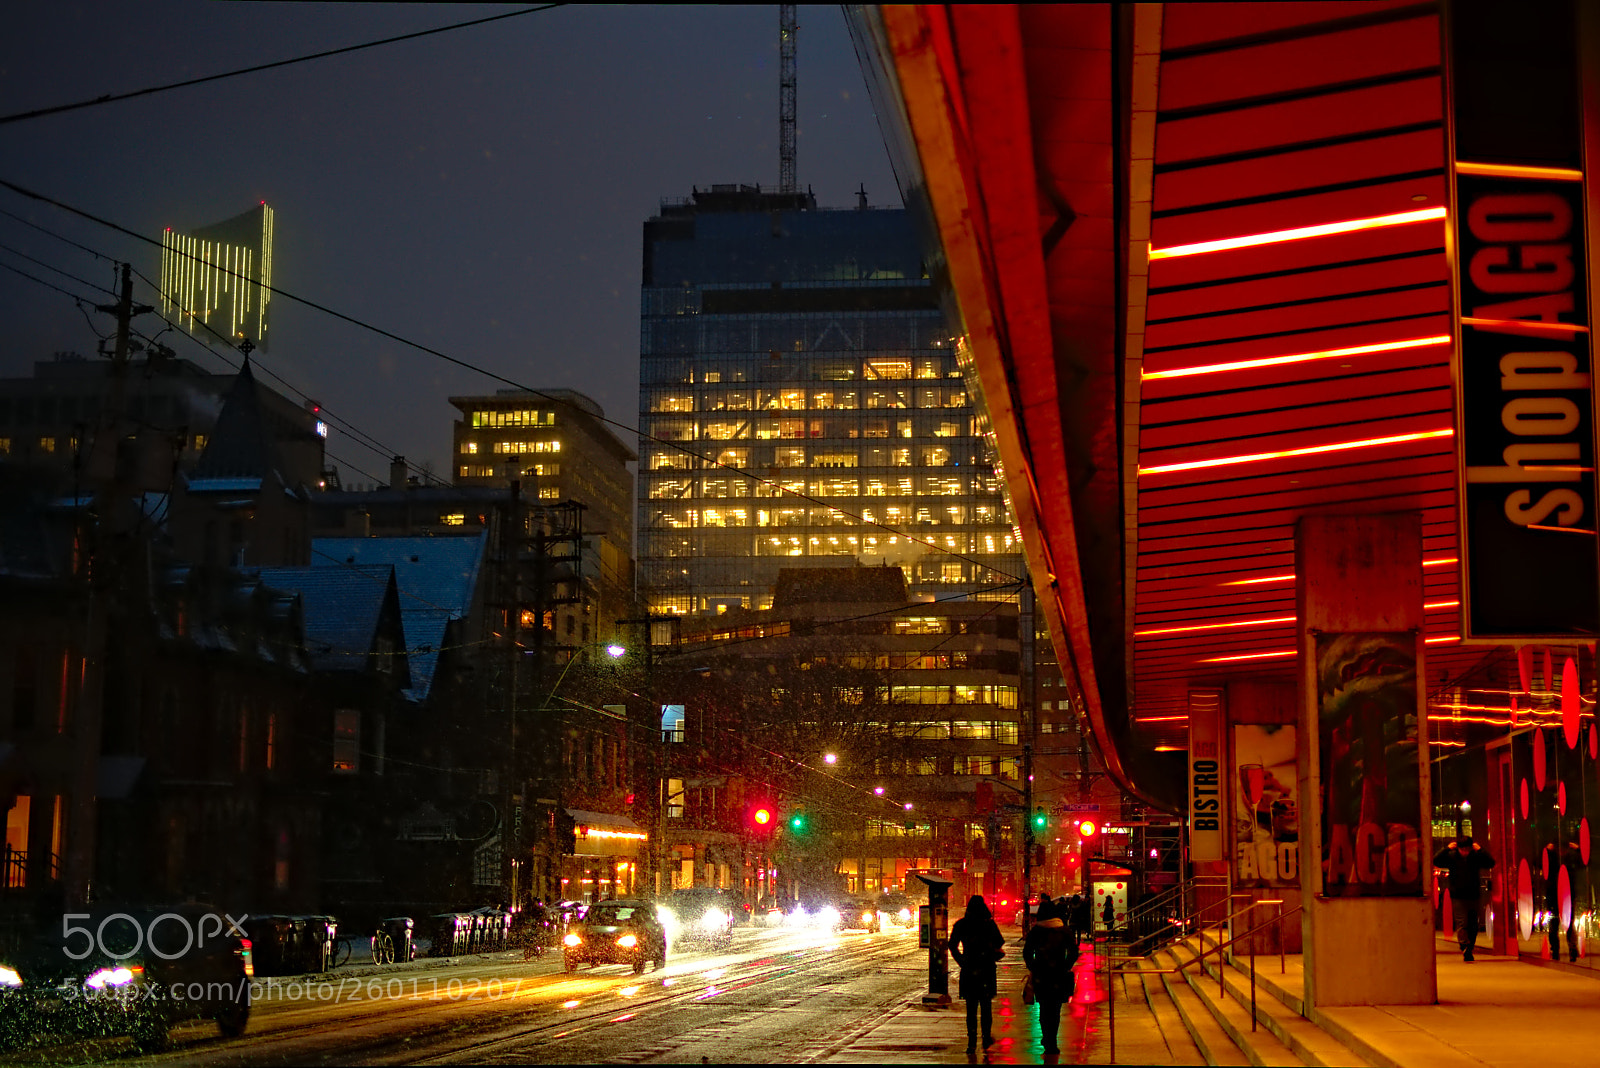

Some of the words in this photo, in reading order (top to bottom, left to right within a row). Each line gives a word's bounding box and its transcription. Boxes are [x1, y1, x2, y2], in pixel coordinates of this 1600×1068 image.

[1467, 194, 1575, 342] AGO
[1193, 760, 1219, 831] BISTRO
[1327, 822, 1419, 884] AGO
